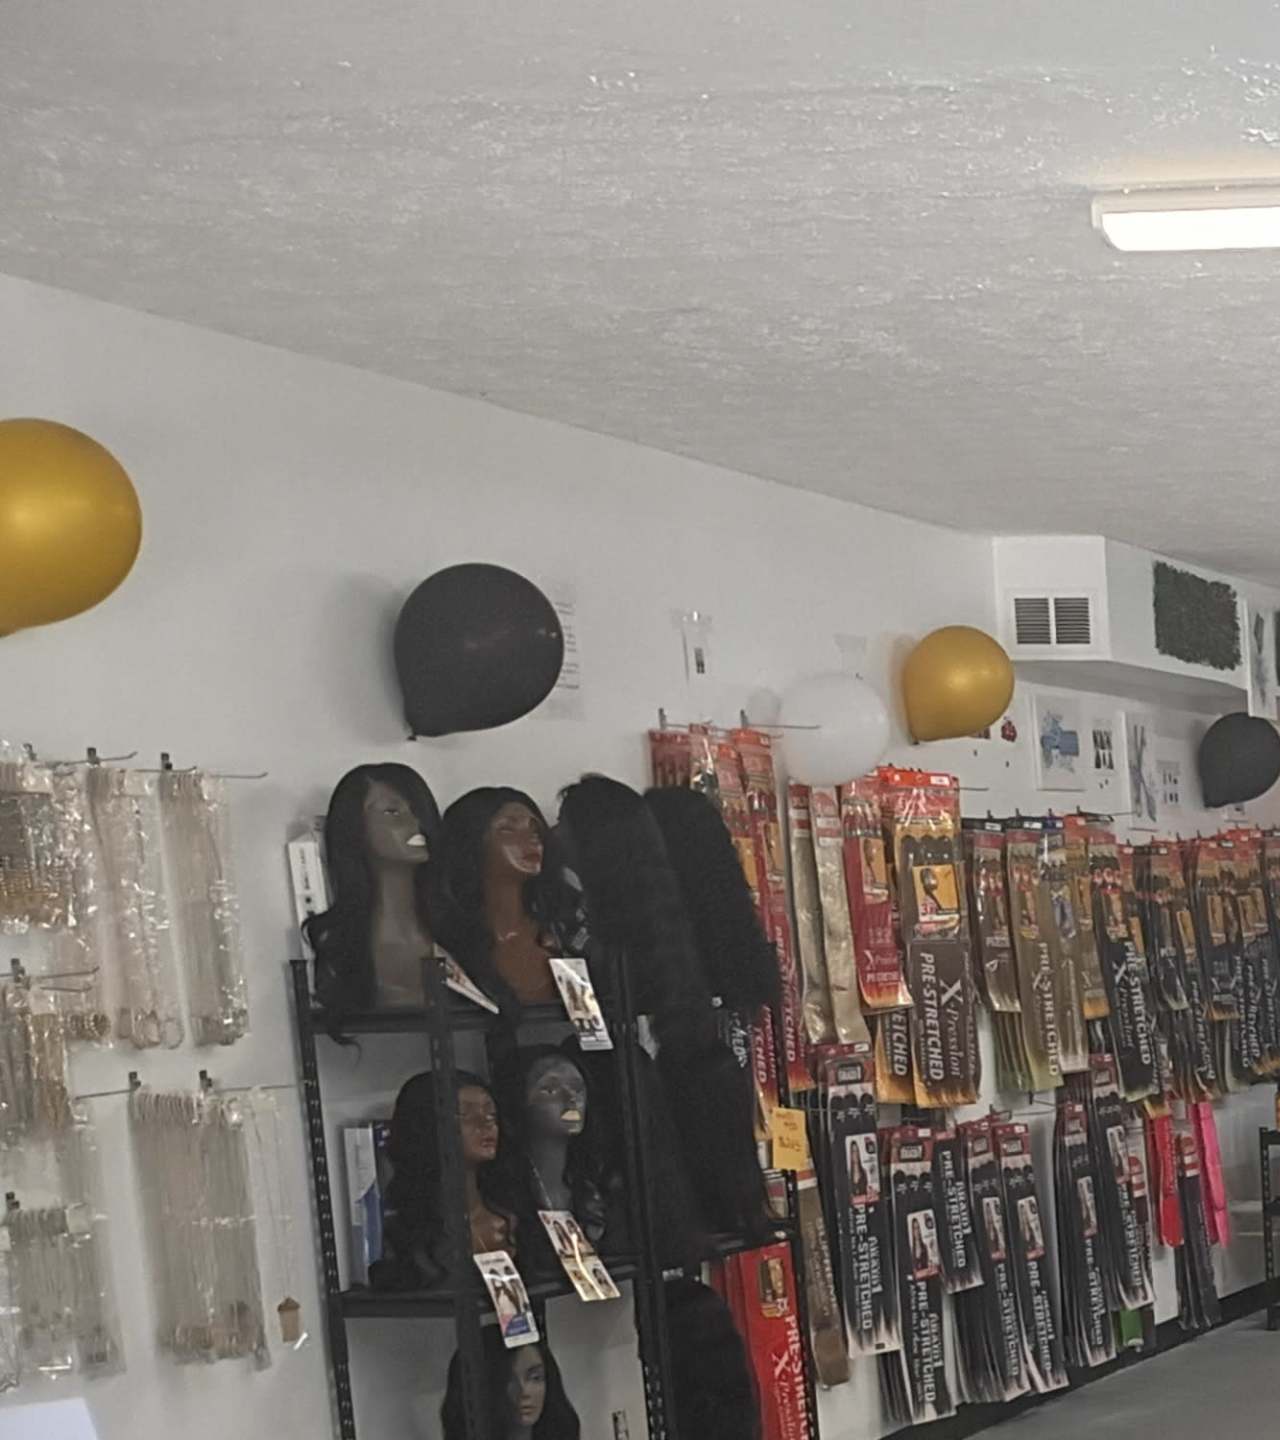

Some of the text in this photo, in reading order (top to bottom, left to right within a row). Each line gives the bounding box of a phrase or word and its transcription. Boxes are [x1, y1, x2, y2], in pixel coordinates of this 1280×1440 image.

[920, 952, 944, 1080] PRE-STRETCHED
[1039, 941, 1060, 1077] PRE-STRETCHED
[1124, 941, 1151, 1065] PRE-STRETCHED
[854, 1203, 872, 1330] PRE-STRETCHED
[942, 1150, 966, 1268] PRE-STRETCHED
[917, 1280, 936, 1403] PRE-STRETCHED
